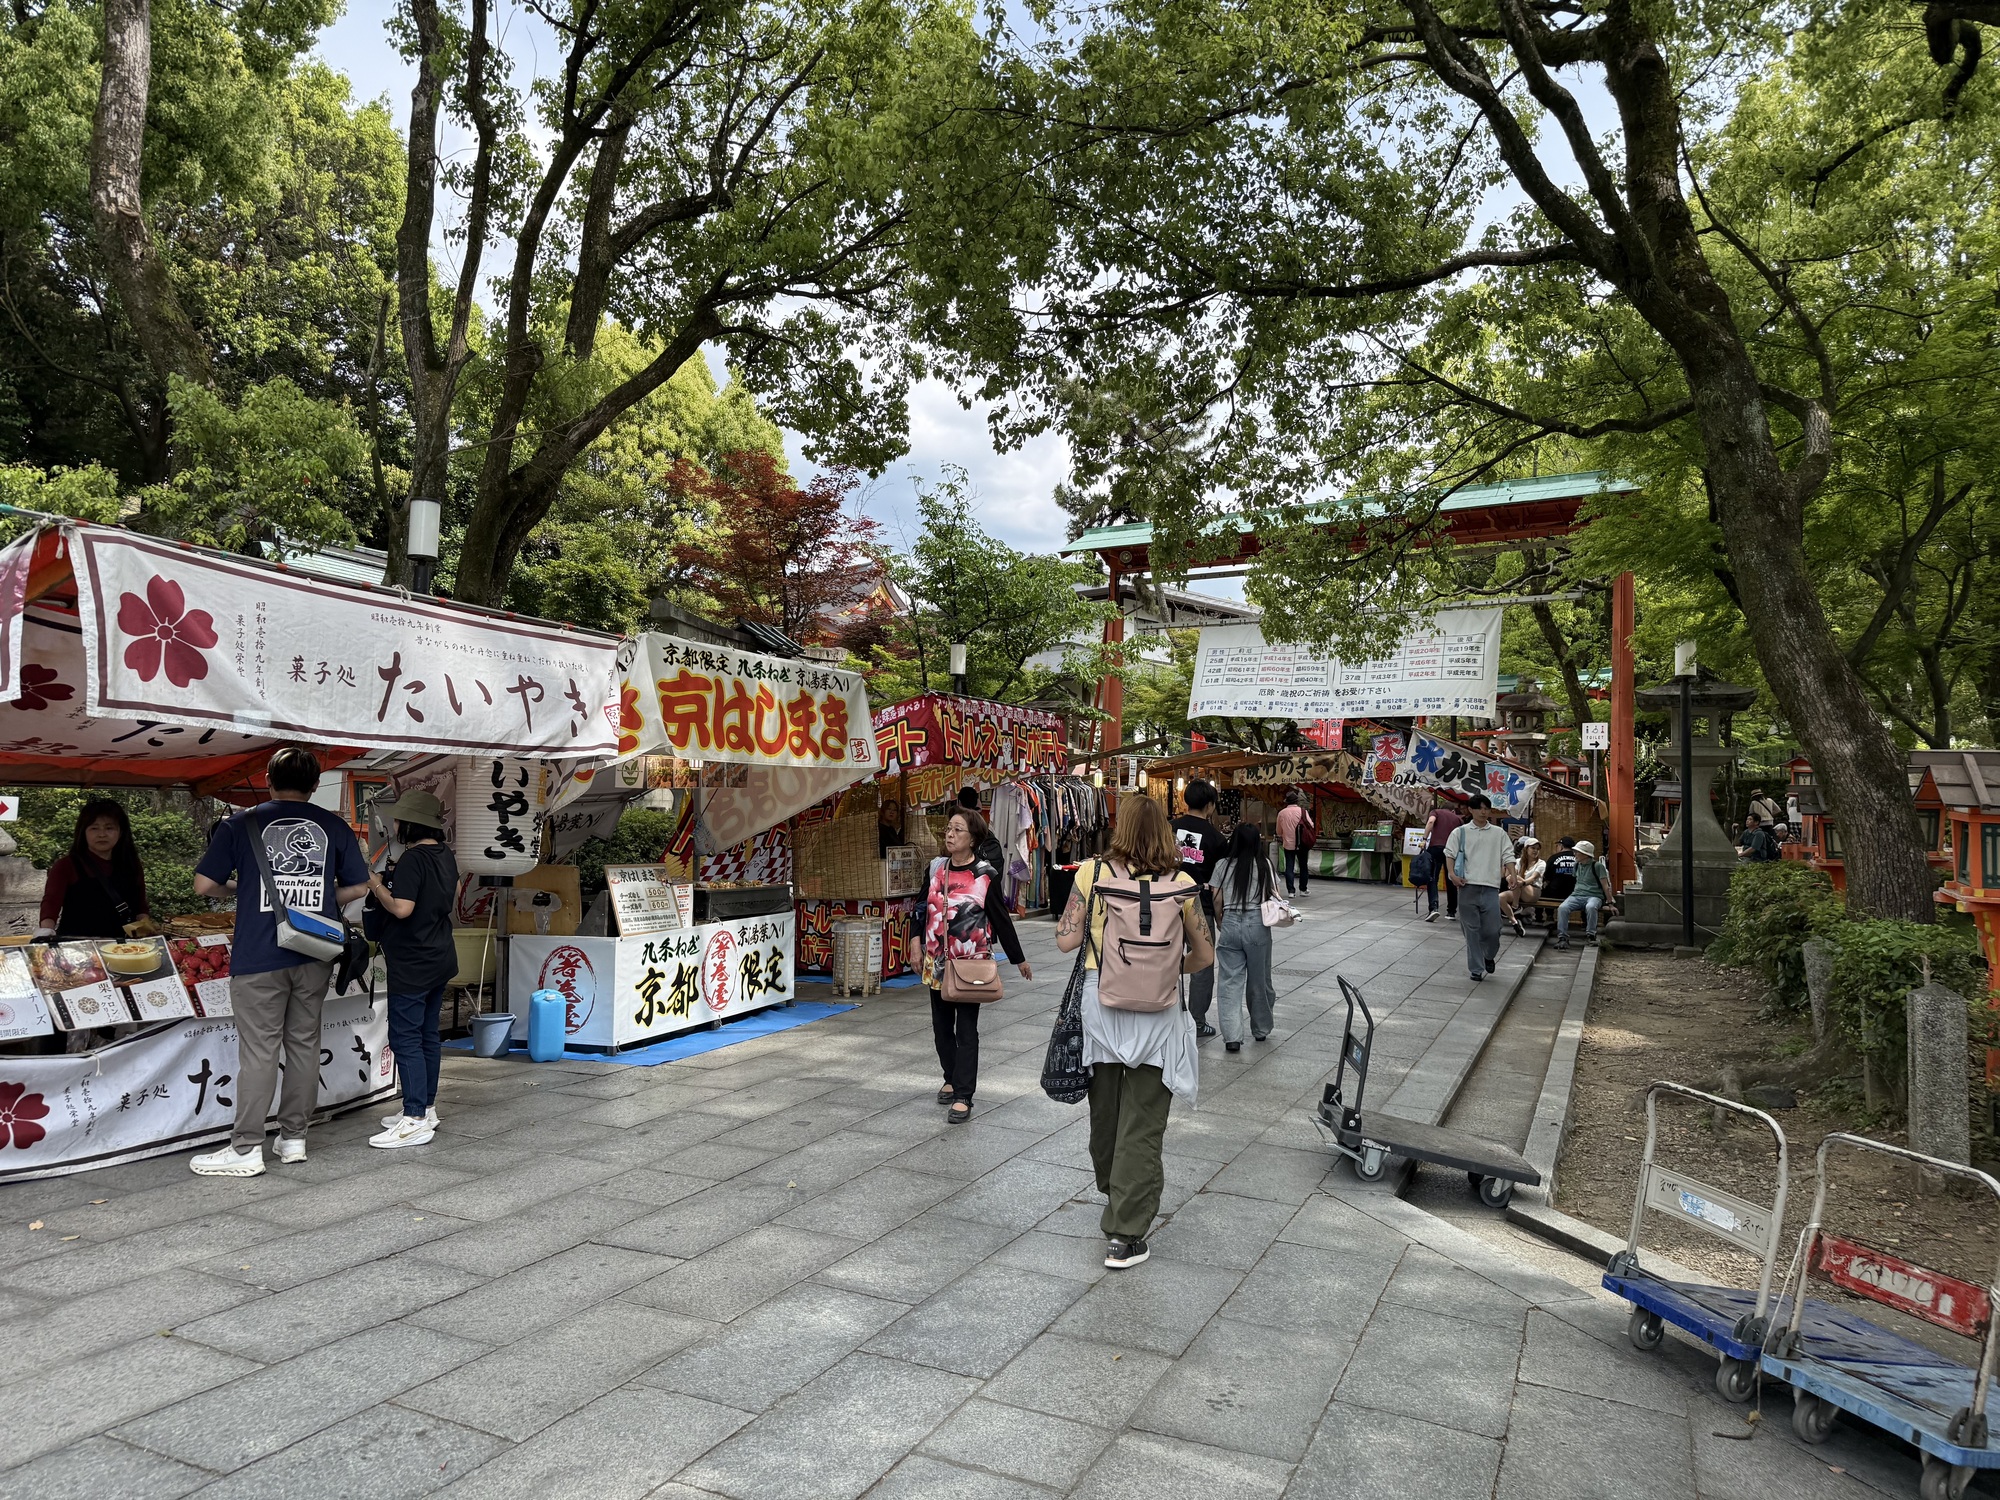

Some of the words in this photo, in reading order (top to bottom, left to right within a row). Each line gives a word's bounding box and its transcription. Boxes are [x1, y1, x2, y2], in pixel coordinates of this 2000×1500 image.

[286, 654, 357, 688] 菓子処
[662, 642, 732, 676] 京都限定
[737, 658, 792, 684] 九条ねぎ
[795, 669, 850, 693] 京湯葉入り
[377, 651, 588, 738] たいやき
[1334, 686, 1391, 697] をお受け下さい
[656, 667, 850, 763] 京はしまき
[484, 757, 529, 859] いやき
[297, 879, 321, 887] Made
[618, 869, 656, 883] 京はしまき
[264, 889, 320, 907] DYALLS
[641, 934, 700, 966] 九条ねぎ
[737, 921, 785, 947] 京湯葉入り
[634, 961, 700, 1028] 京都
[738, 944, 787, 1003] 限定
[28, 992, 47, 1026] チーズ
[115, 1083, 171, 1113] 菓子処
